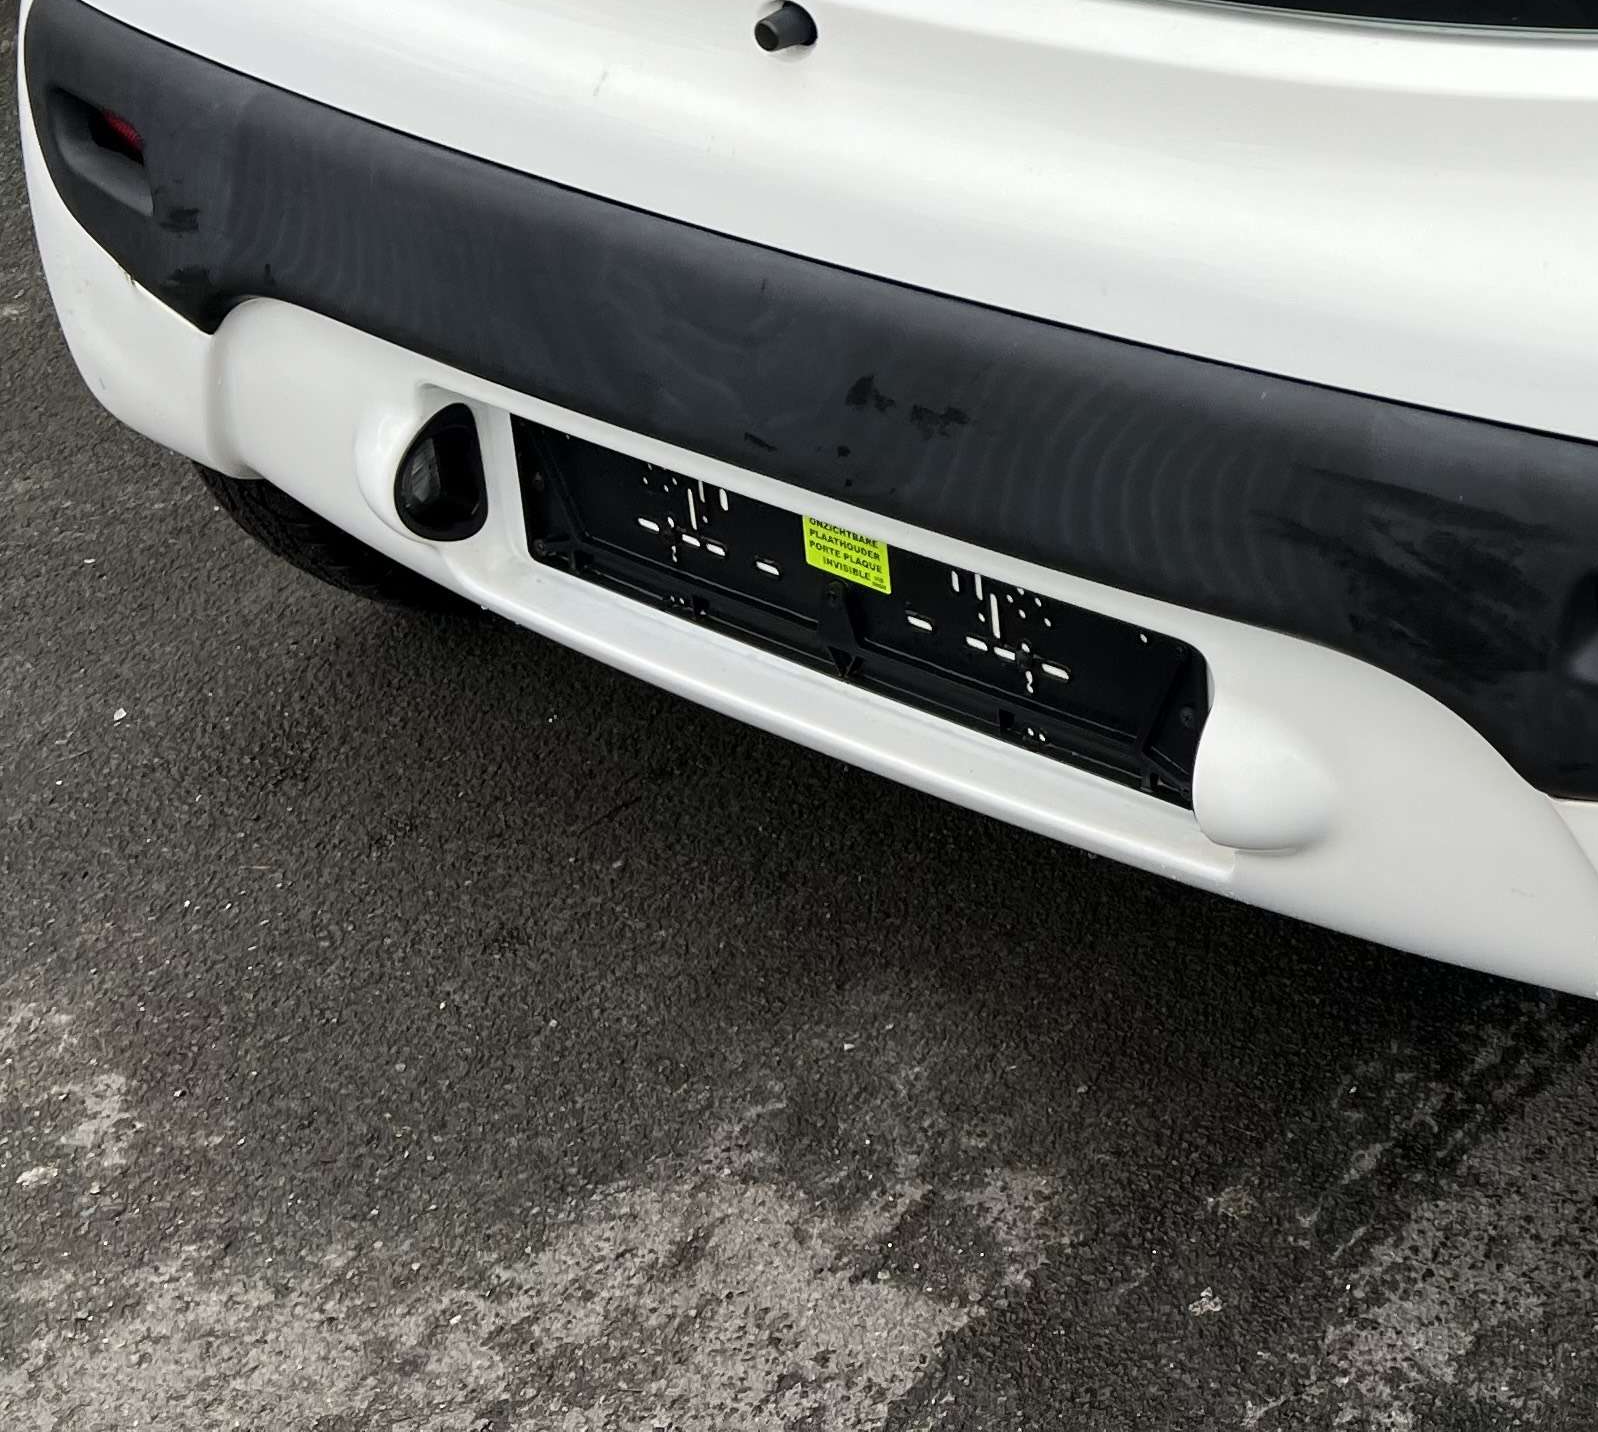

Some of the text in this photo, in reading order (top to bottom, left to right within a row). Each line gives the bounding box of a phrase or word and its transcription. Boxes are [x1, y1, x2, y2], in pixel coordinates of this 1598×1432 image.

[809, 517, 879, 549] ONZICHTBARE
[809, 528, 880, 560] PLAATHOUDER
[809, 540, 882, 574] PORTE PLAQUE
[823, 556, 871, 581] INVISIBLE
